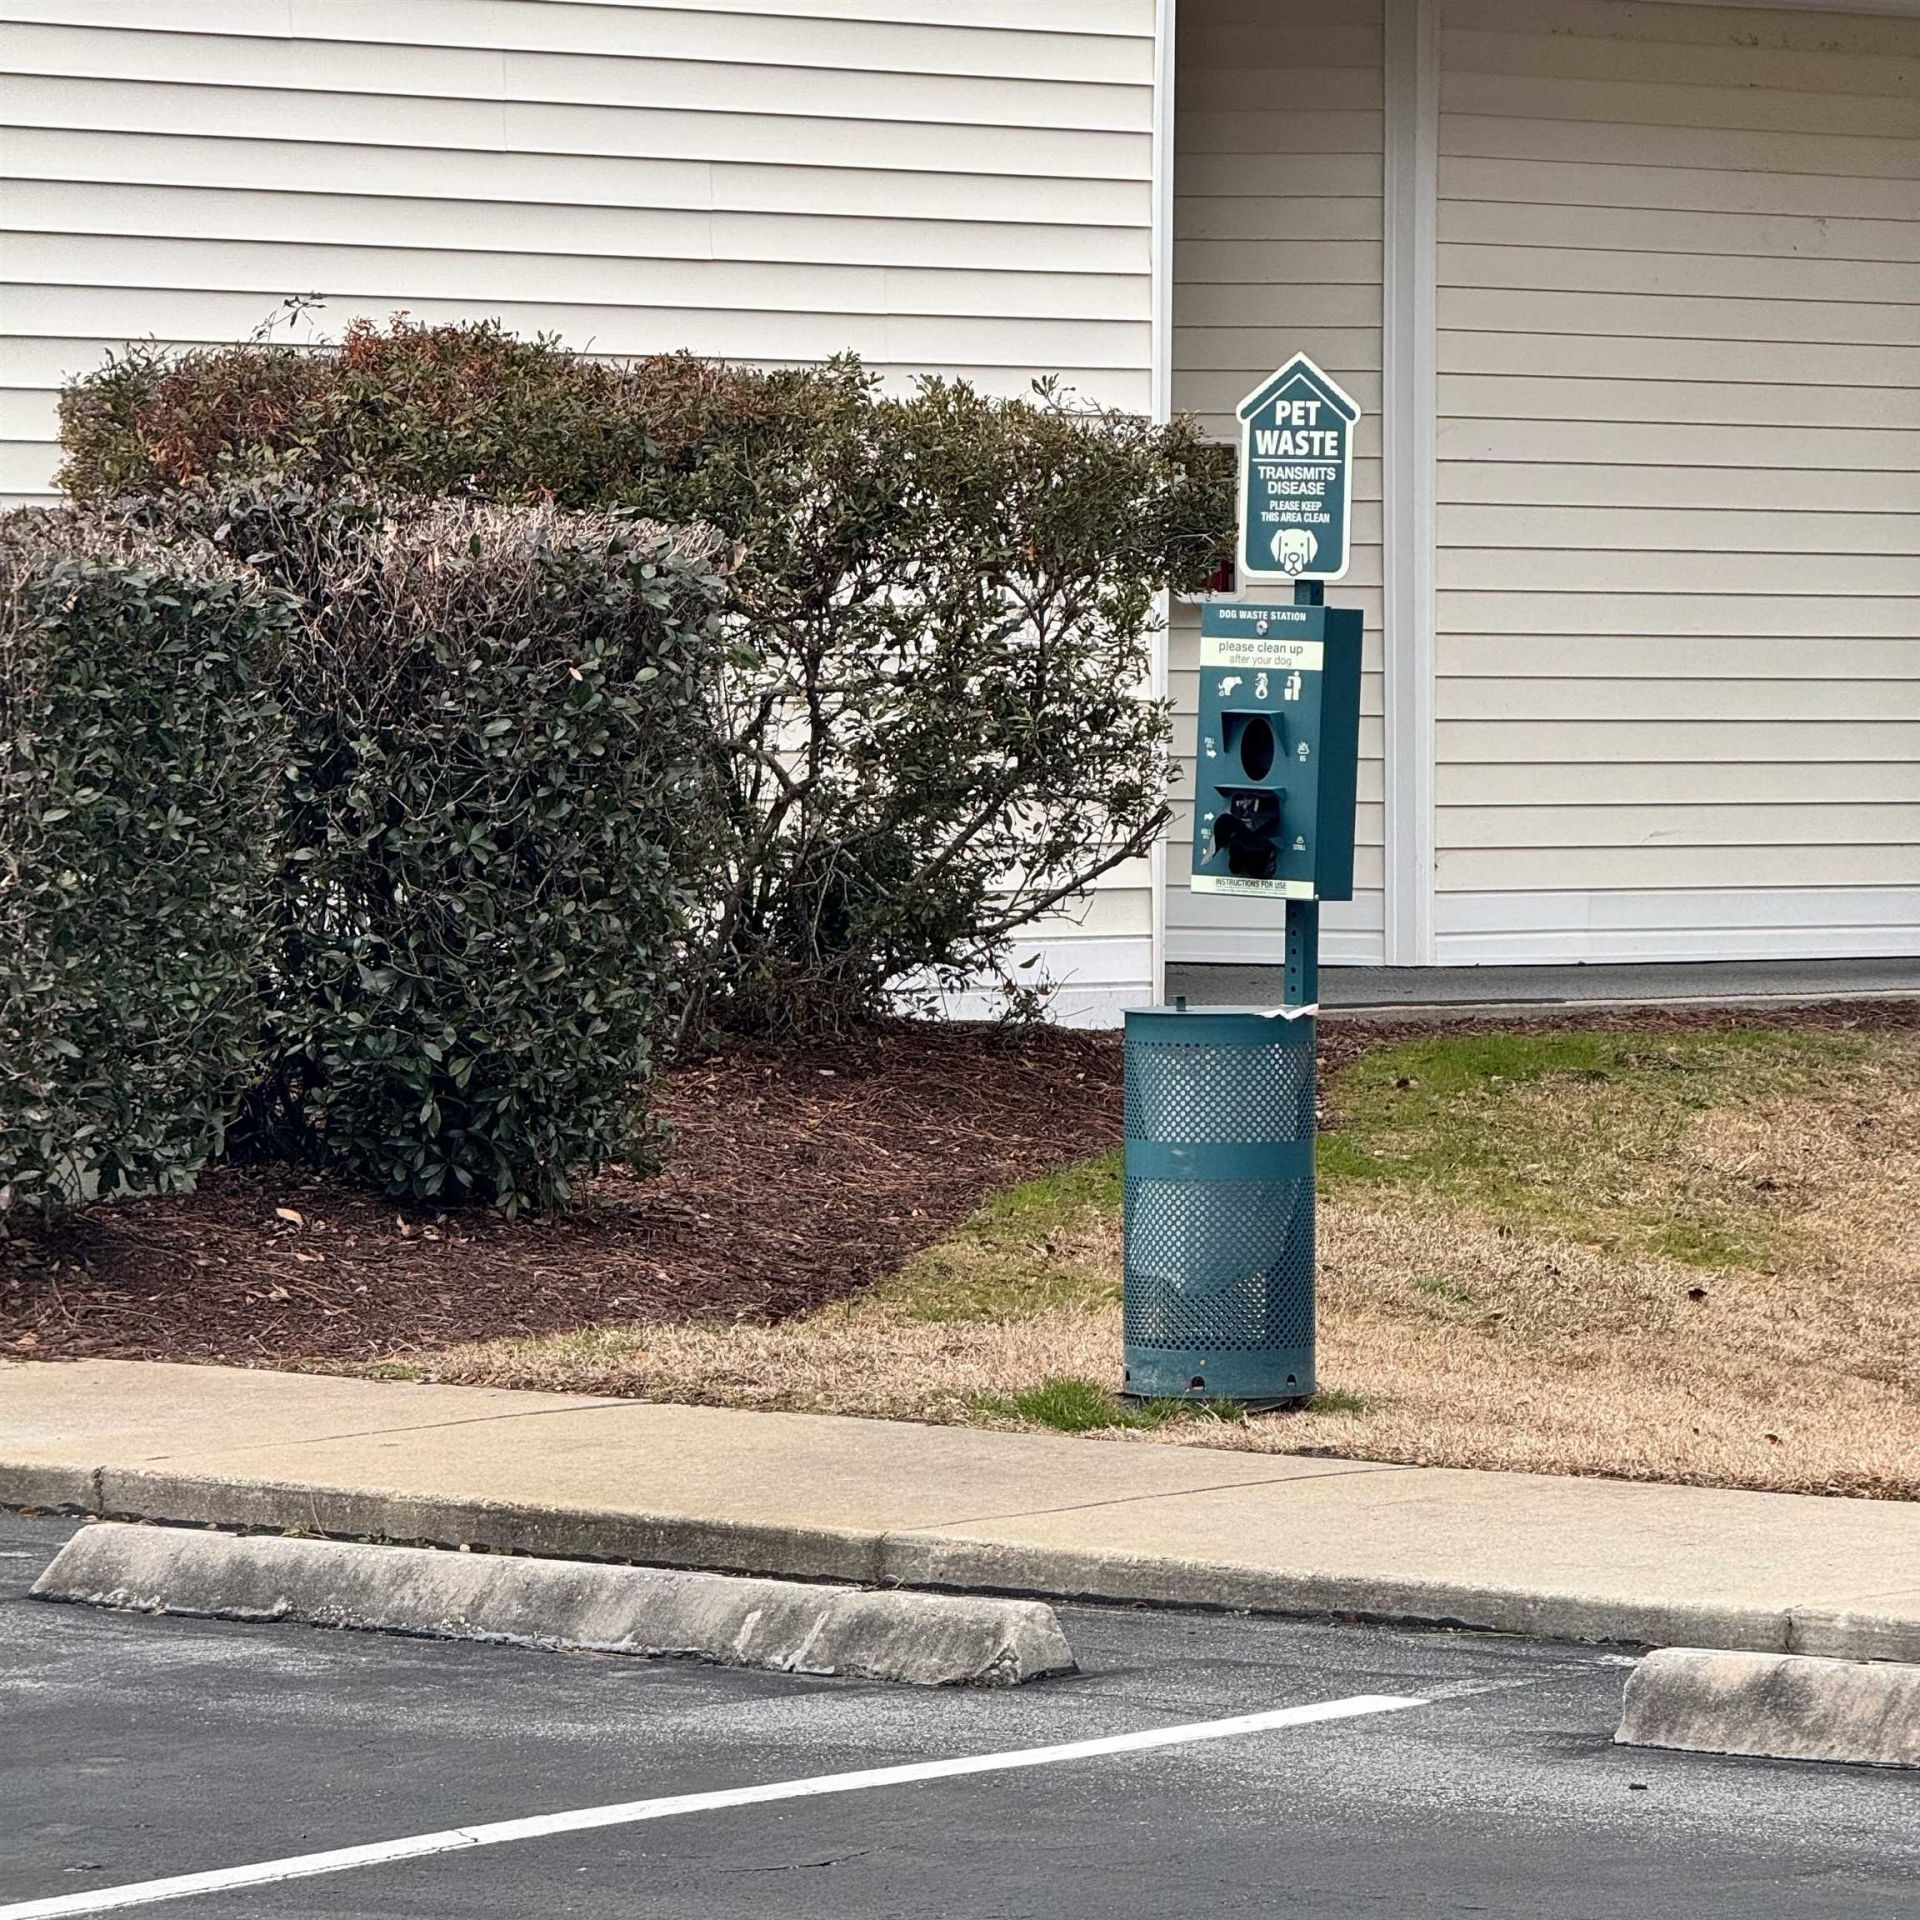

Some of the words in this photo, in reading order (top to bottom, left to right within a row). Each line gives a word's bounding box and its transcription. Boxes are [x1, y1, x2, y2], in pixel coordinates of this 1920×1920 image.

[1275, 400, 1321, 426] PET
[1255, 430, 1339, 457] WASTE
[1257, 465, 1336, 481] TRANSMITS
[1267, 481, 1325, 496] DISEASE
[1269, 500, 1300, 511] PLEASE
[1301, 501, 1322, 511] KEEP
[1261, 511, 1280, 522] THIS
[1280, 511, 1302, 523] AREA
[1303, 513, 1330, 523] CLEAN
[1219, 609, 1237, 619] DOG
[1239, 610, 1269, 620] WASTE
[1270, 611, 1306, 621] STATION
[1219, 641, 1255, 653] please
[1257, 643, 1286, 653] clean
[1289, 645, 1304, 656] up
[1229, 654, 1250, 664] after
[1252, 656, 1272, 666] your
[1274, 656, 1292, 668] dog
[1215, 878, 1260, 888] INSTRUCTIONS
[1261, 880, 1273, 888] FOR
